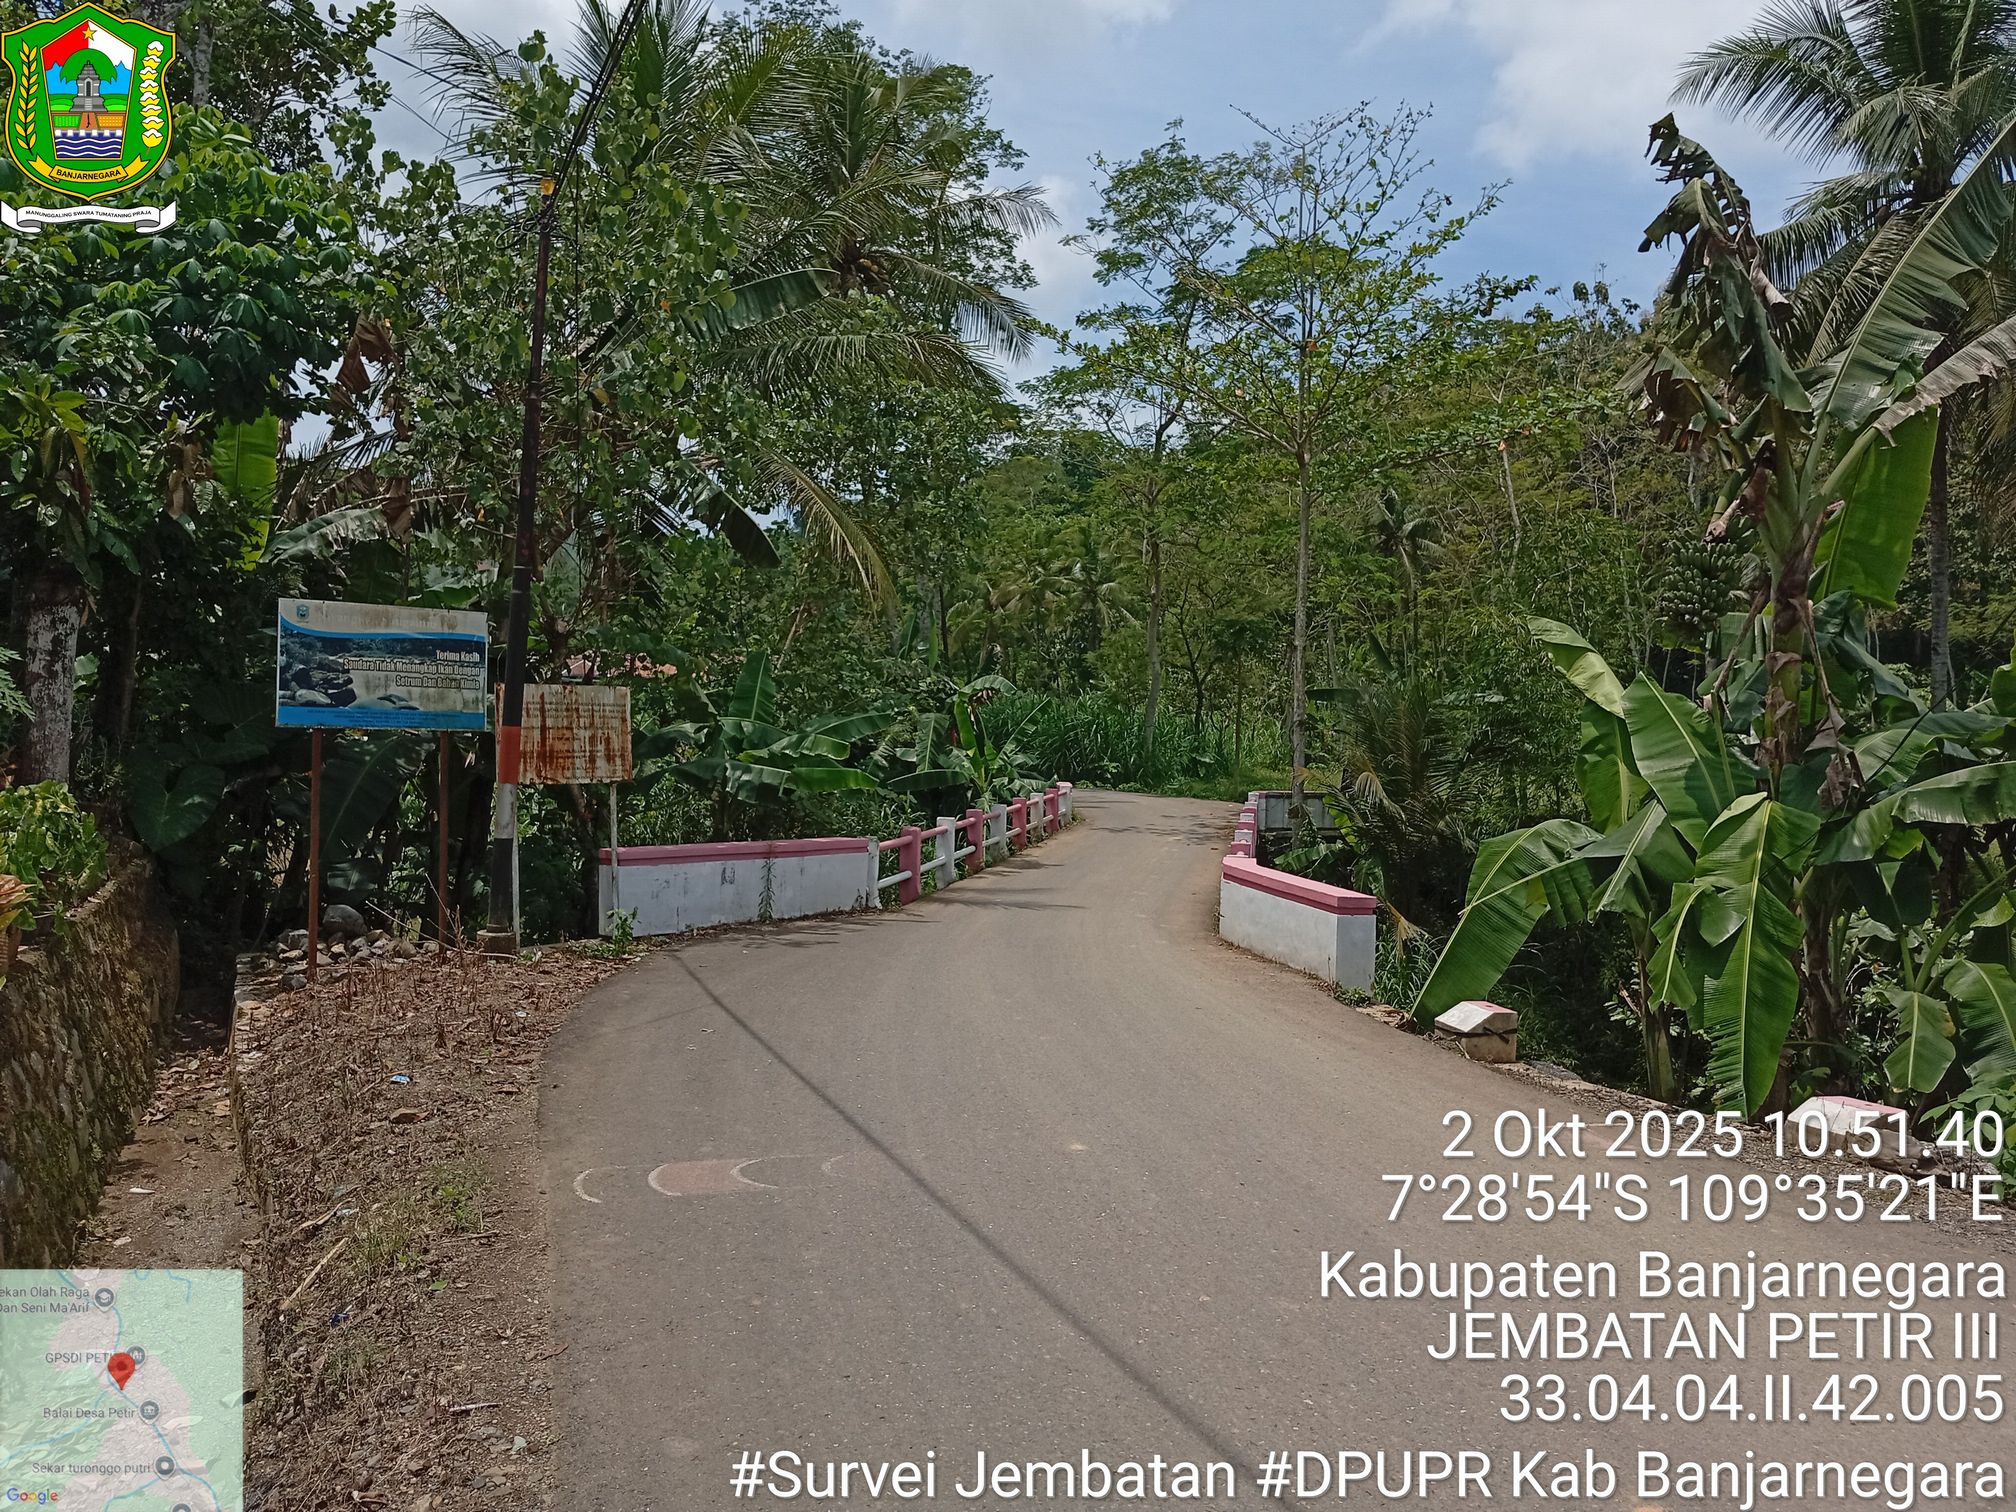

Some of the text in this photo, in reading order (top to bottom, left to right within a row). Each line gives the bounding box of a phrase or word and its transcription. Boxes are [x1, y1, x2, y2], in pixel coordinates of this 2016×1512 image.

[436, 650, 480, 662] Terima Kasih
[343, 659, 480, 676] Saudara Tidak Menangkap Ikan Dengan
[395, 676, 422, 687] Setrum
[422, 677, 437, 688] Dan
[460, 679, 480, 690] Kimia
